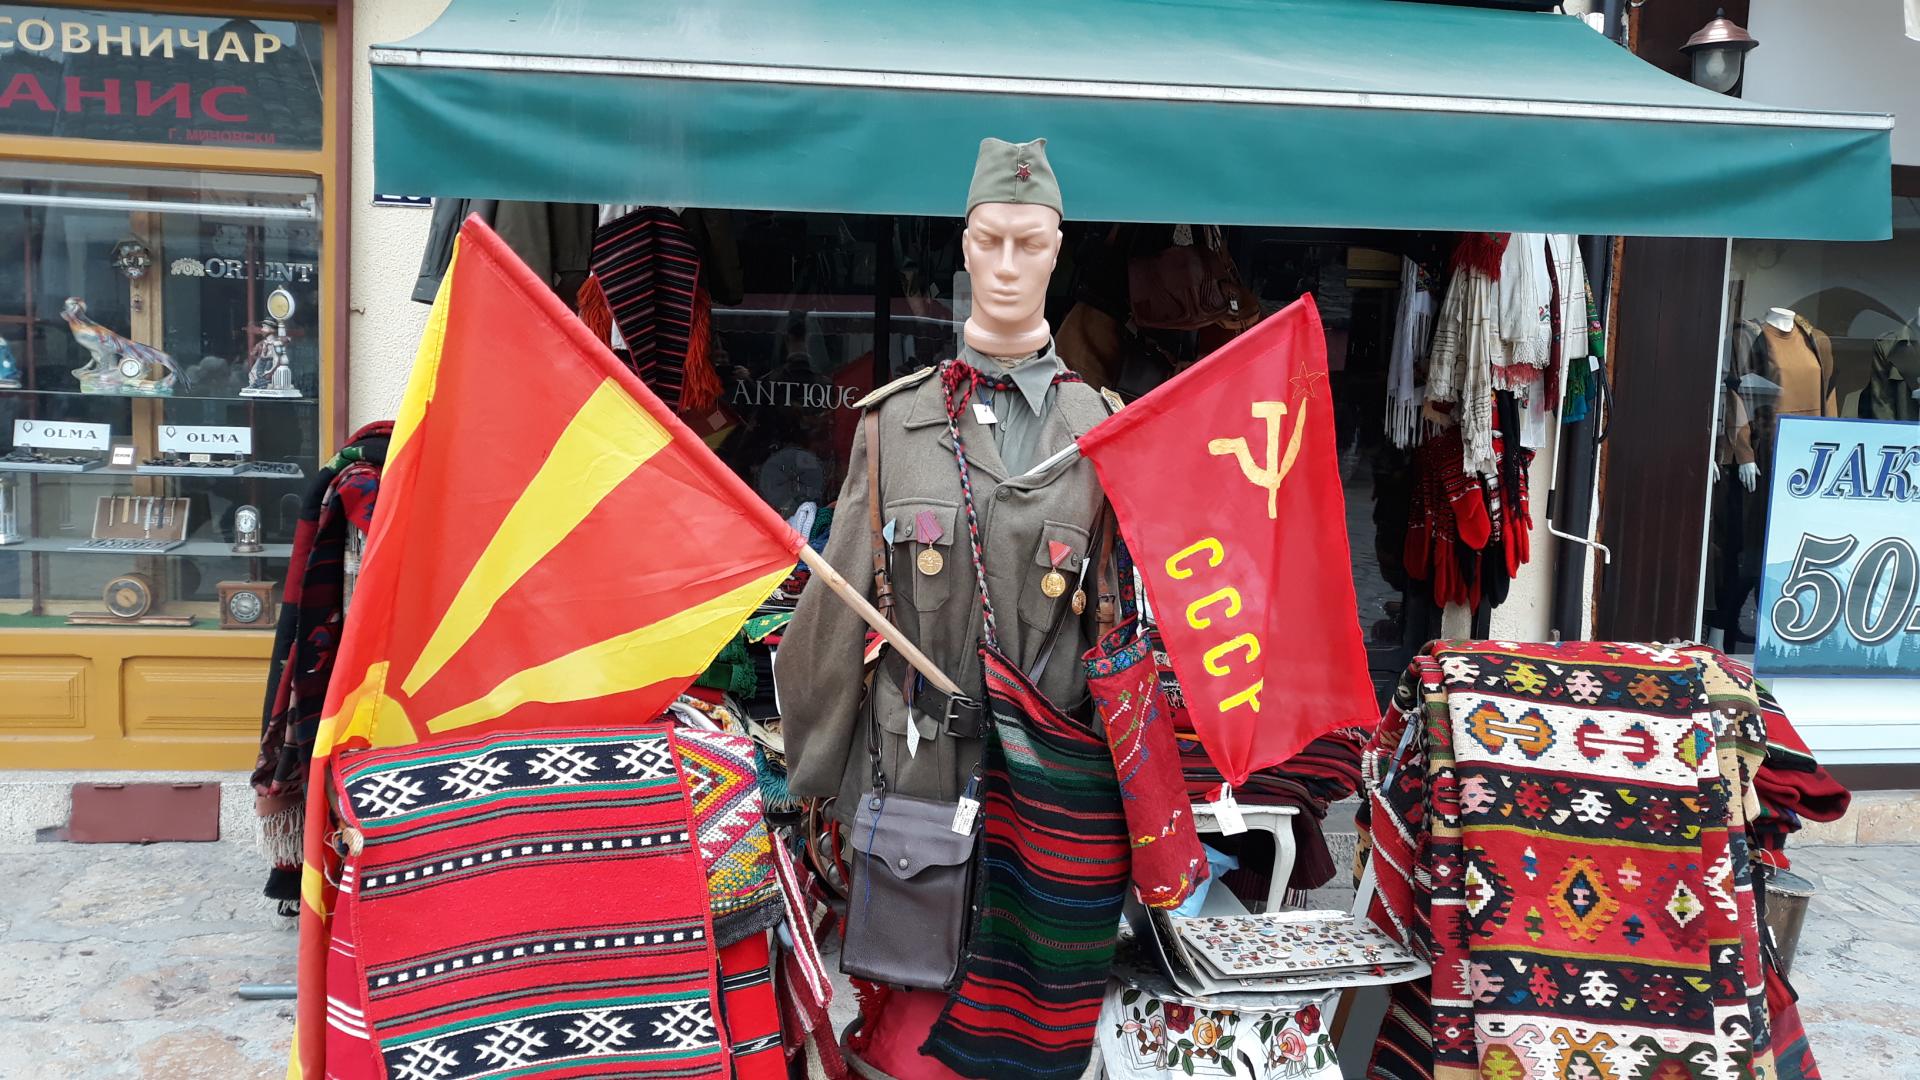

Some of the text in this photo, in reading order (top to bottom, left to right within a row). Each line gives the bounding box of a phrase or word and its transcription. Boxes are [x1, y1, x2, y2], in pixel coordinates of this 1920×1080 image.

[731, 379, 860, 410] ANTIQUE
[43, 427, 97, 440] OLMA
[186, 432, 240, 444] OLMA
[1787, 443, 1920, 503] JAK
